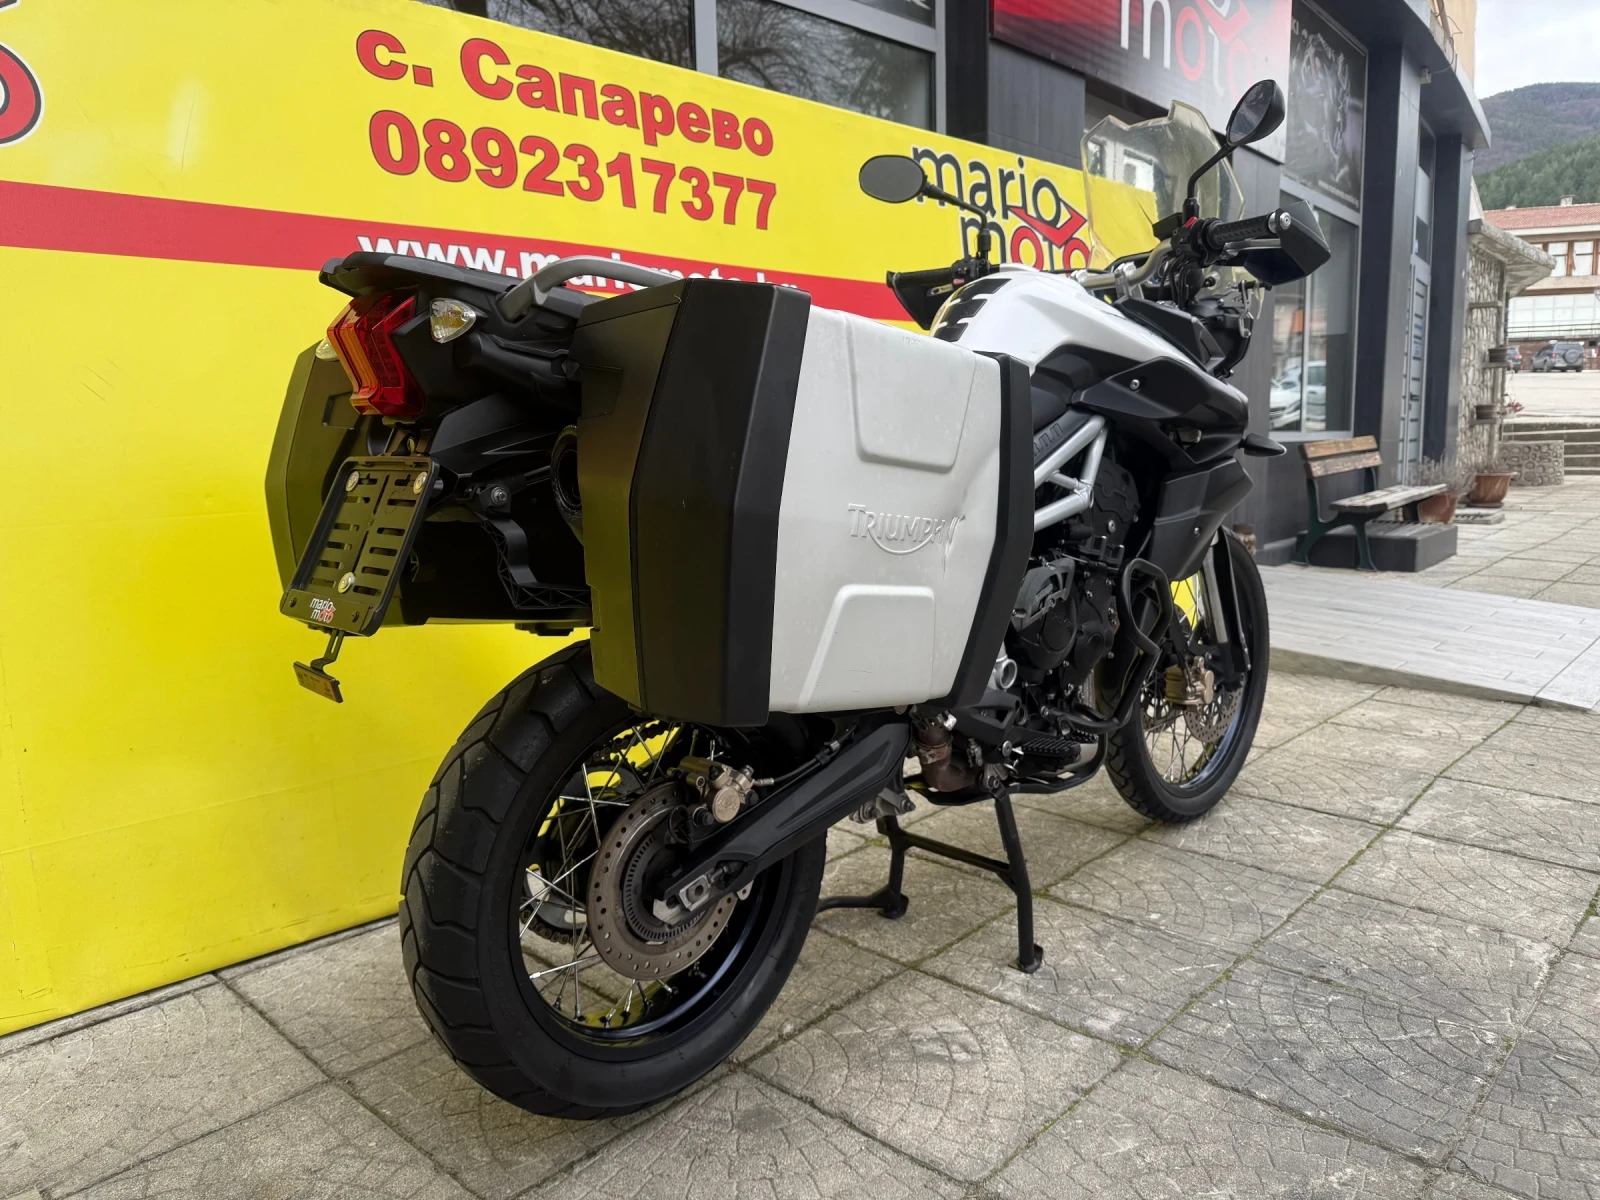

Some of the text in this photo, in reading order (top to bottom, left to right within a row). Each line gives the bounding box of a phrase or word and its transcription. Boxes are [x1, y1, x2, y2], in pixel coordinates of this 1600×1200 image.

[356, 30, 775, 157] с. Сапарево
[369, 110, 778, 231] 0892317377
[912, 147, 1062, 229] mario
[960, 216, 1092, 276] moto
[848, 502, 960, 545] TRIUMPH
[310, 598, 334, 611] mario
[310, 609, 334, 623] moto
